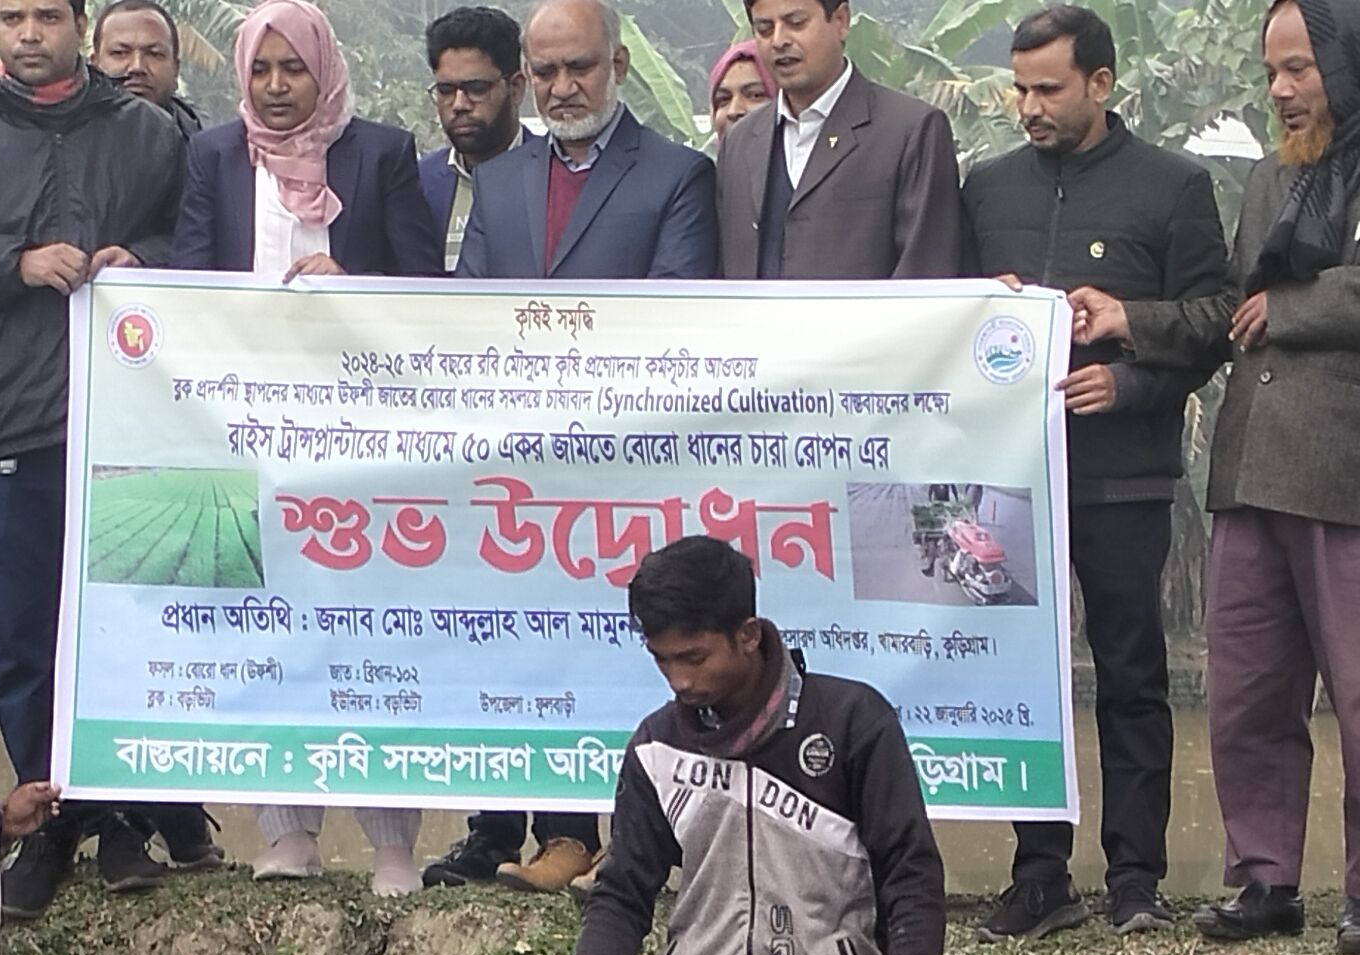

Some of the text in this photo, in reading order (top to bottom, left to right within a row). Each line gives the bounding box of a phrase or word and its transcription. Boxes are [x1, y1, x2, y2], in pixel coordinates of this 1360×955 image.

[515, 300, 596, 340] কৃষিই সমৃদ্ধি
[342, 351, 404, 376] ২০২৪-২৫
[409, 345, 435, 376] অর্থ
[439, 352, 474, 378] বছরে
[478, 346, 500, 377] রবি
[556, 348, 582, 386] কৃষি
[585, 355, 641, 379] প্রণোদনা
[704, 357, 758, 380] আওতায়
[173, 379, 192, 401] ব্লক
[197, 373, 238, 401] প্রদর্শনী
[243, 381, 289, 406] স্থাপনের
[293, 383, 334, 406] মাধ্যমে
[379, 386, 417, 408] জাতের
[421, 387, 457, 410] বোরো
[461, 388, 495, 410] ধানের
[547, 389, 593, 411] চাষাবাদ
[597, 386, 722, 418] (Synchronized
[727, 387, 833, 418] Cultivation)
[839, 391, 910, 415] বাস্তবায়নের
[914, 391, 951, 415] লক্ষ্যে
[227, 413, 275, 458] রাইস
[397, 429, 457, 464] মাধ্যমে
[462, 432, 490, 463] ৫০
[498, 431, 545, 465] একর
[550, 421, 616, 465] জমিতে
[623, 430, 679, 466] বোরো
[688, 430, 742, 467] ধানের
[748, 429, 788, 469] চারা
[795, 431, 852, 471] রোপন
[859, 436, 890, 471] এর
[275, 496, 448, 571] শুভ
[161, 601, 216, 634] প্রধান
[222, 595, 292, 634] অতিথি
[314, 604, 374, 637] জনাব
[382, 605, 423, 637] মোঃ
[430, 604, 519, 646] আব্দুল্লাহ
[523, 607, 570, 640] আল
[186, 661, 217, 679] বোরো
[220, 661, 238, 680] ধান
[329, 664, 353, 682] জাত
[147, 689, 165, 709] ব্লক
[330, 687, 373, 712] ইউনিয়ন
[479, 690, 524, 714] উপজেলা
[915, 705, 932, 724] ২২
[982, 706, 1014, 726] ২০২৫
[114, 737, 272, 777] বাস্তবায়নে
[305, 732, 373, 791] কৃষি
[381, 741, 536, 785] সম্প্রসারণ
[909, 742, 1008, 796] ড়িগ্রাম
[673, 758, 732, 791] LON
[759, 780, 818, 831] DON
